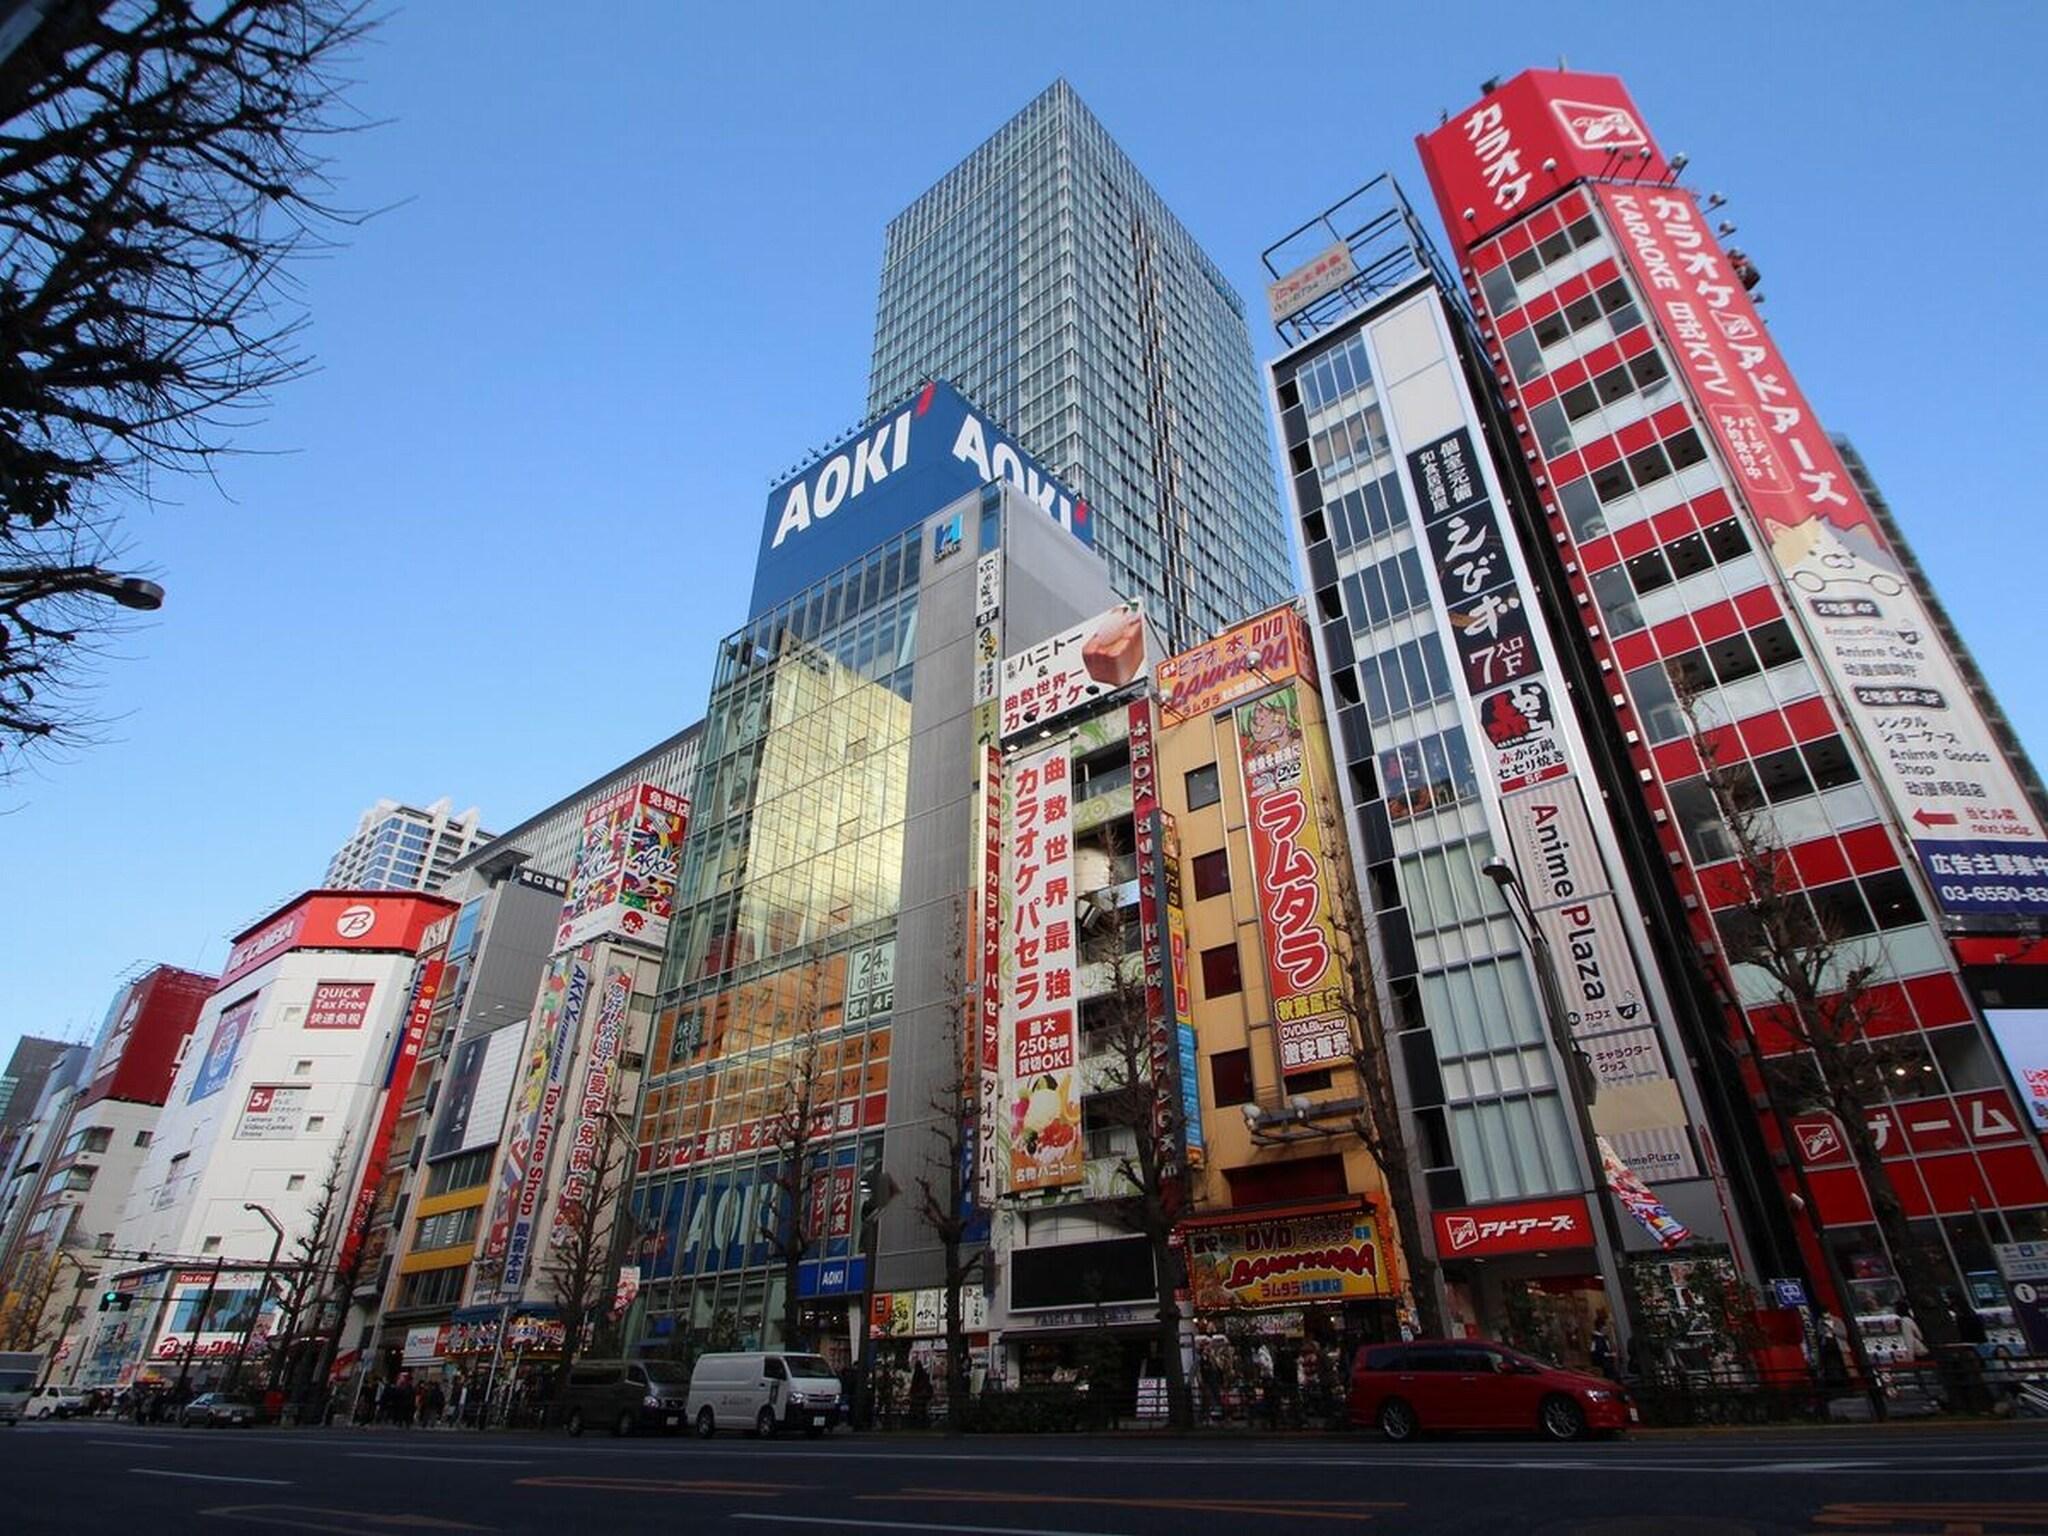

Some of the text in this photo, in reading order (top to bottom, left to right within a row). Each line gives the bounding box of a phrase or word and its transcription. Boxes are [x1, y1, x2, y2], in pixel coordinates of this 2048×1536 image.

[1464, 102, 1532, 210] カラオケ
[1611, 194, 1680, 291] KARAOKE
[1650, 195, 1848, 506] カラオケ アドアーズ
[772, 411, 912, 549] AOKI
[952, 413, 1073, 534] AOKI
[1018, 633, 1084, 672] ハニトー
[1252, 615, 1284, 646] DVD
[1036, 664, 1049, 679] &
[1004, 683, 1085, 734] カラオケ
[1890, 749, 1991, 763] Anime Goods
[1894, 763, 1935, 776] Shop
[649, 790, 691, 818] 免税店
[1014, 766, 1041, 1011] カラオケパセラ
[1043, 754, 1072, 1001] 曲数世界最強
[1258, 787, 1330, 990] ラムタラ
[1531, 803, 1575, 898] Anime
[1561, 904, 1606, 1001] Plaza
[314, 1000, 367, 1011] Tax Free
[317, 987, 362, 999] QUICK
[567, 963, 587, 1023] AKKY
[1584, 1010, 1612, 1022] カフェ
[519, 1166, 544, 1217] Shop
[1478, 1214, 1575, 1240] アドアーズ
[821, 1271, 845, 1286] AOKI
